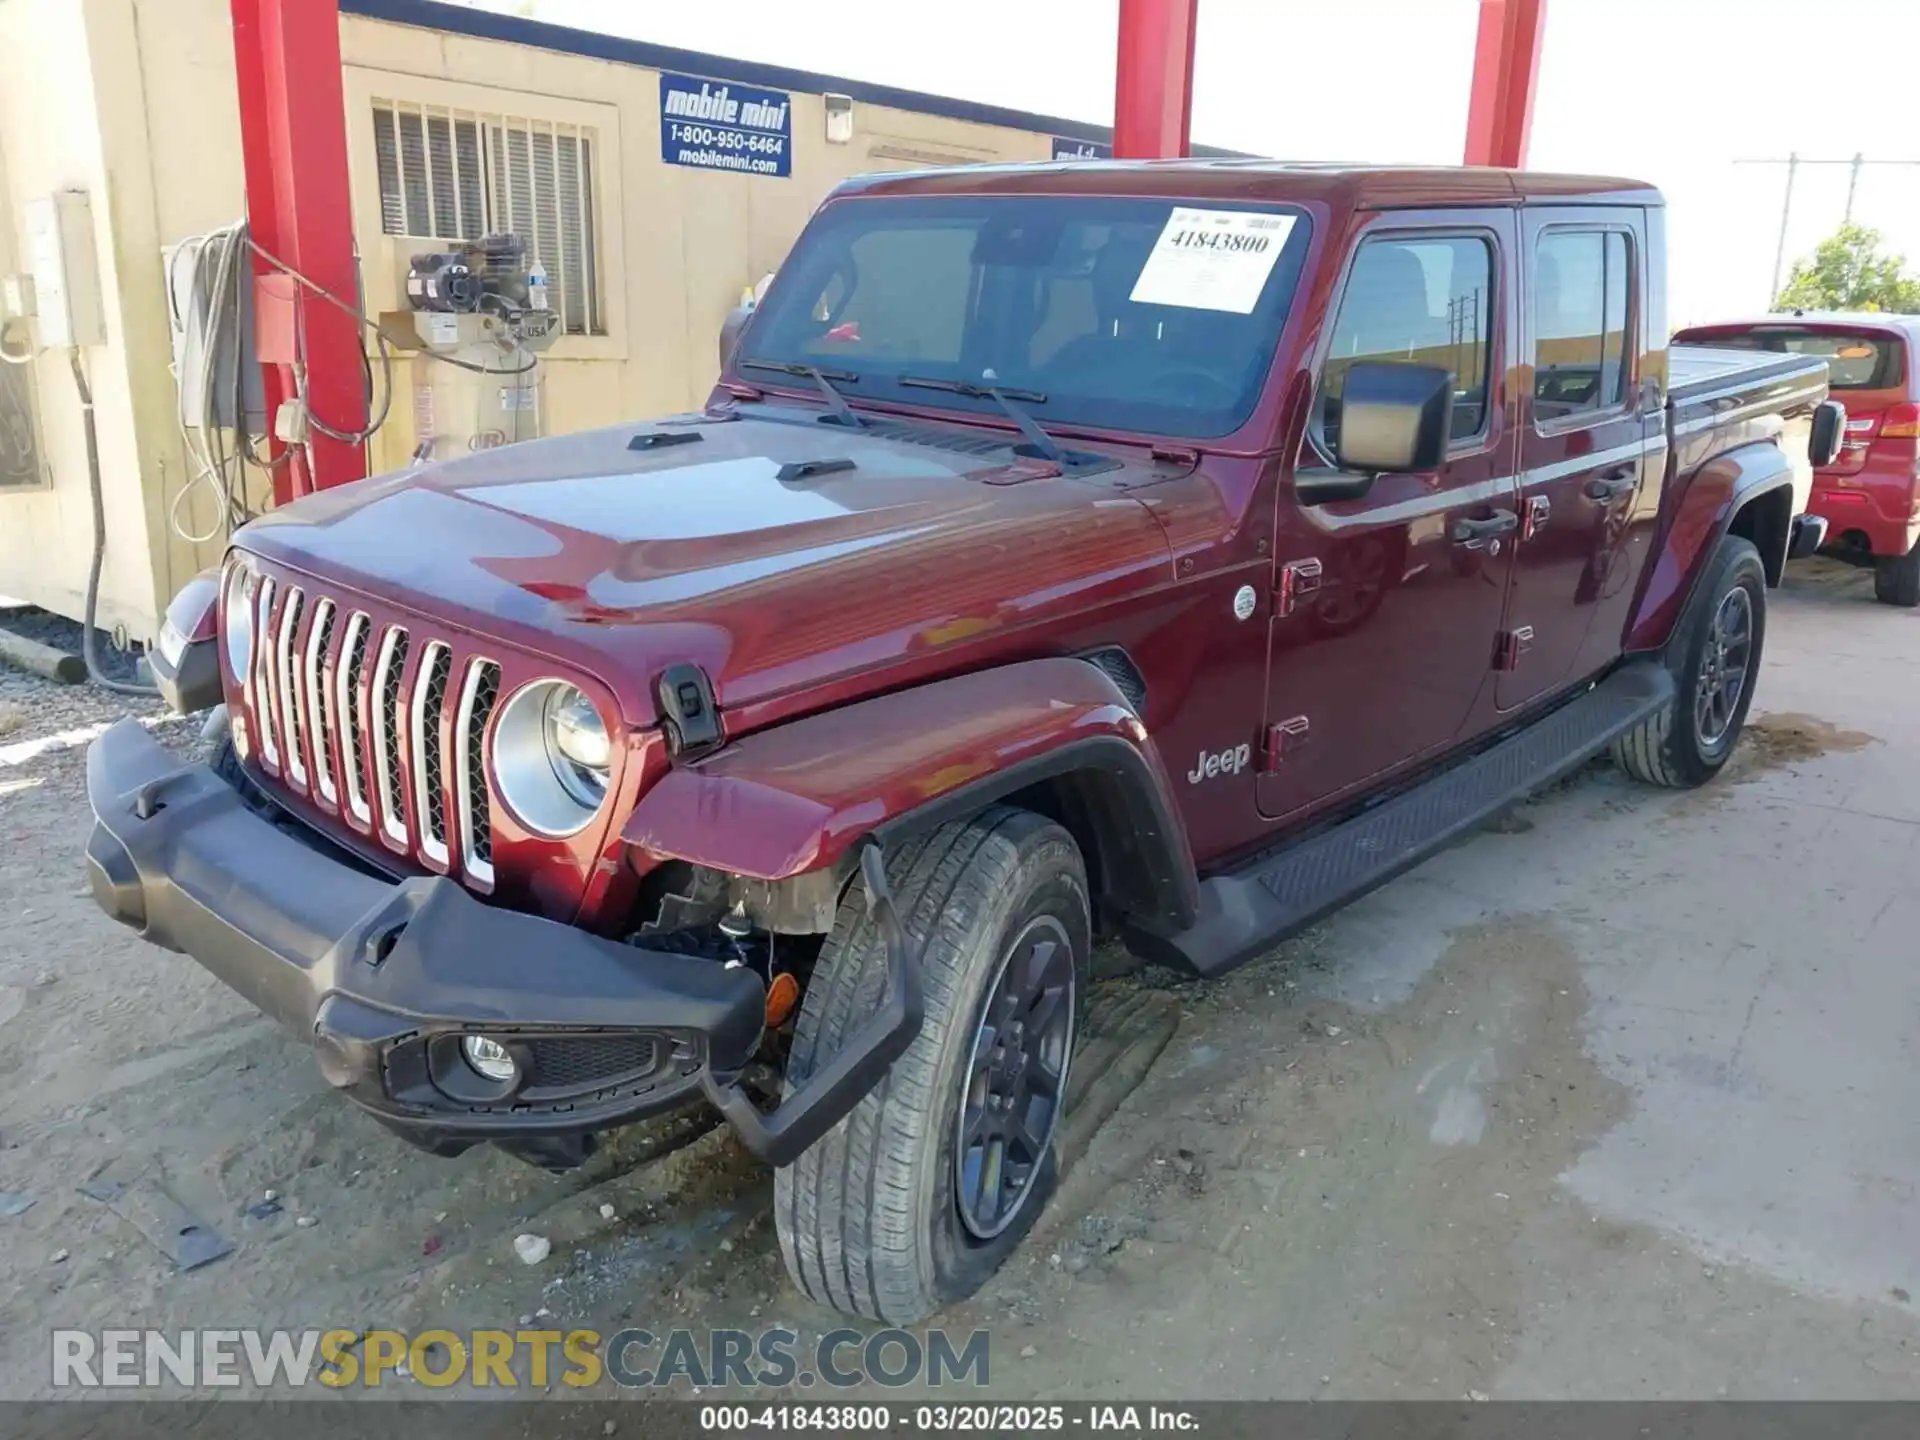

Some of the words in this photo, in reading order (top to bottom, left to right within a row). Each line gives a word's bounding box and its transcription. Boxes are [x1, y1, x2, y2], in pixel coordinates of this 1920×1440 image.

[665, 83, 738, 123] mobile
[740, 99, 788, 130] mini
[671, 124, 782, 155] 1-800-950-6464
[678, 148, 777, 173] mobilemini.com
[1171, 230, 1269, 253] 41843800
[527, 326, 547, 337] USA
[1187, 743, 1250, 784] Jeep
